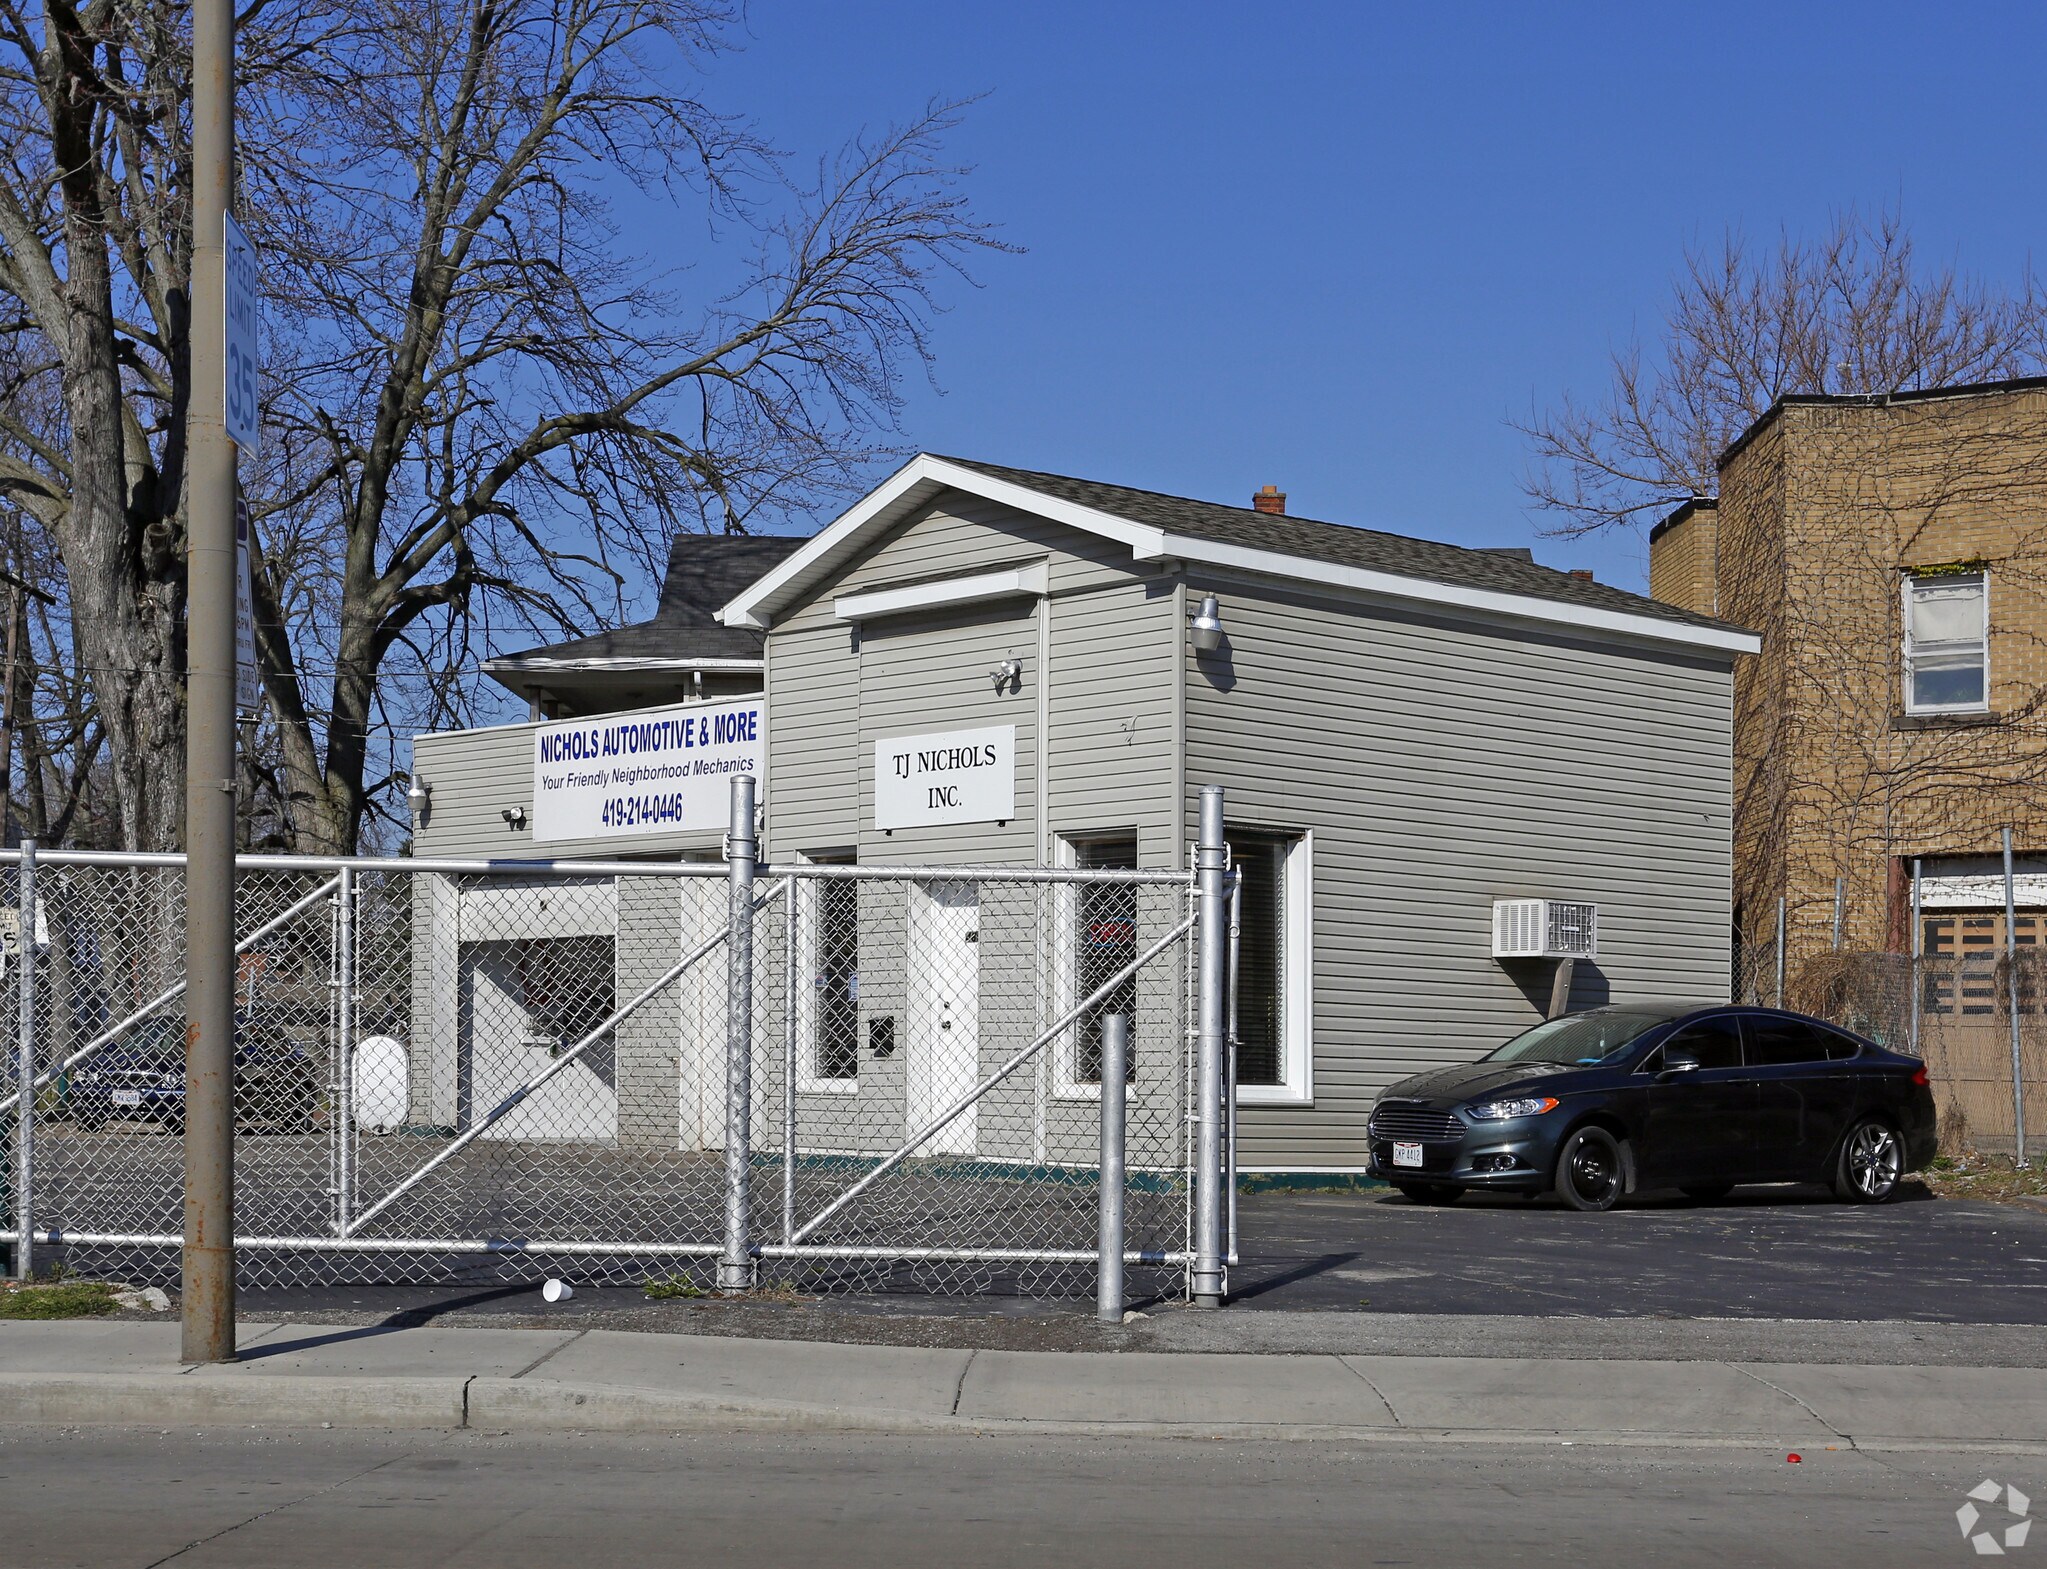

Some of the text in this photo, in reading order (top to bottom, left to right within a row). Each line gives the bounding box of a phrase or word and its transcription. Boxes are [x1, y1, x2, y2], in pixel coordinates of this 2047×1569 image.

[227, 239, 254, 298] SPEED
[229, 284, 251, 337] LIMIT
[229, 342, 254, 433] 35
[241, 686, 255, 701] SIGN
[242, 669, 255, 684] SIDE
[541, 710, 758, 763] NICHOLS AUTOMOTIVE & MORE
[541, 753, 754, 790] Your Friendly Neighborhood Mechanics
[892, 744, 997, 779] TJ NICHOLS
[602, 792, 683, 827] 419-214-0446
[928, 785, 962, 808] INC.
